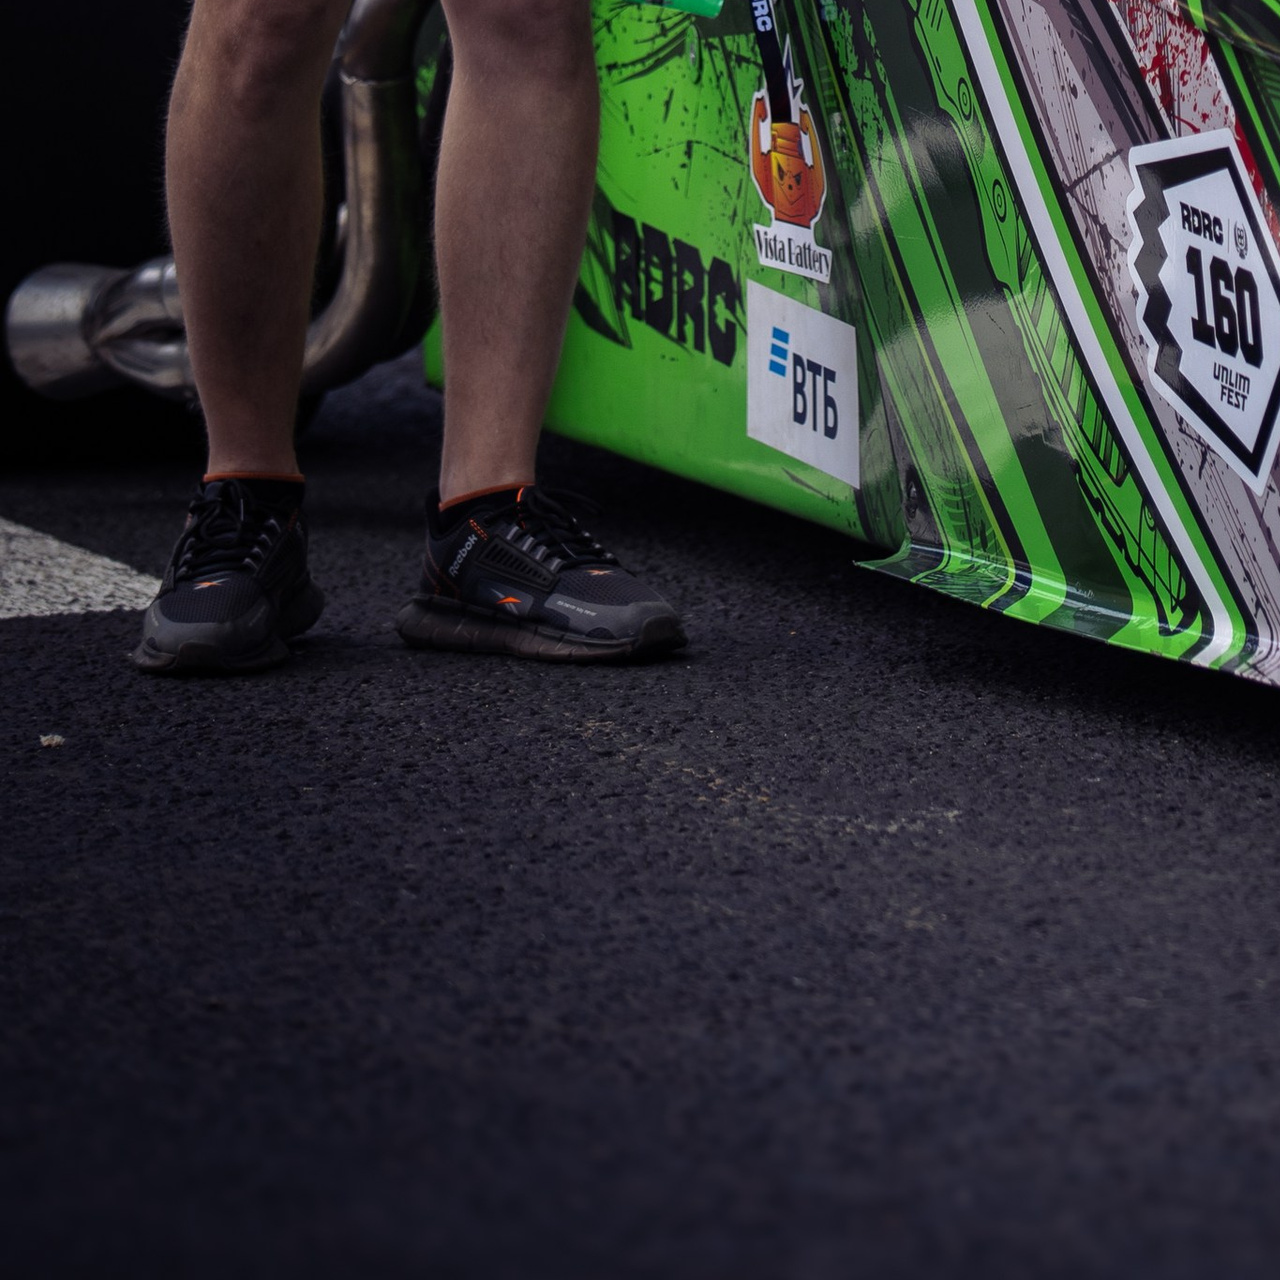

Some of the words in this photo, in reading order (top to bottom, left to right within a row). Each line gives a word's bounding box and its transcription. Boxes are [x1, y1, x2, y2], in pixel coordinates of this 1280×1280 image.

[1179, 200, 1224, 247] RDRC
[755, 229, 787, 264] Vista
[1185, 245, 1265, 370] 160
[792, 352, 839, 441] ВТБ
[1212, 361, 1251, 396] UNLIM
[1220, 383, 1248, 413] FEST
[449, 534, 478, 578] Reebok
